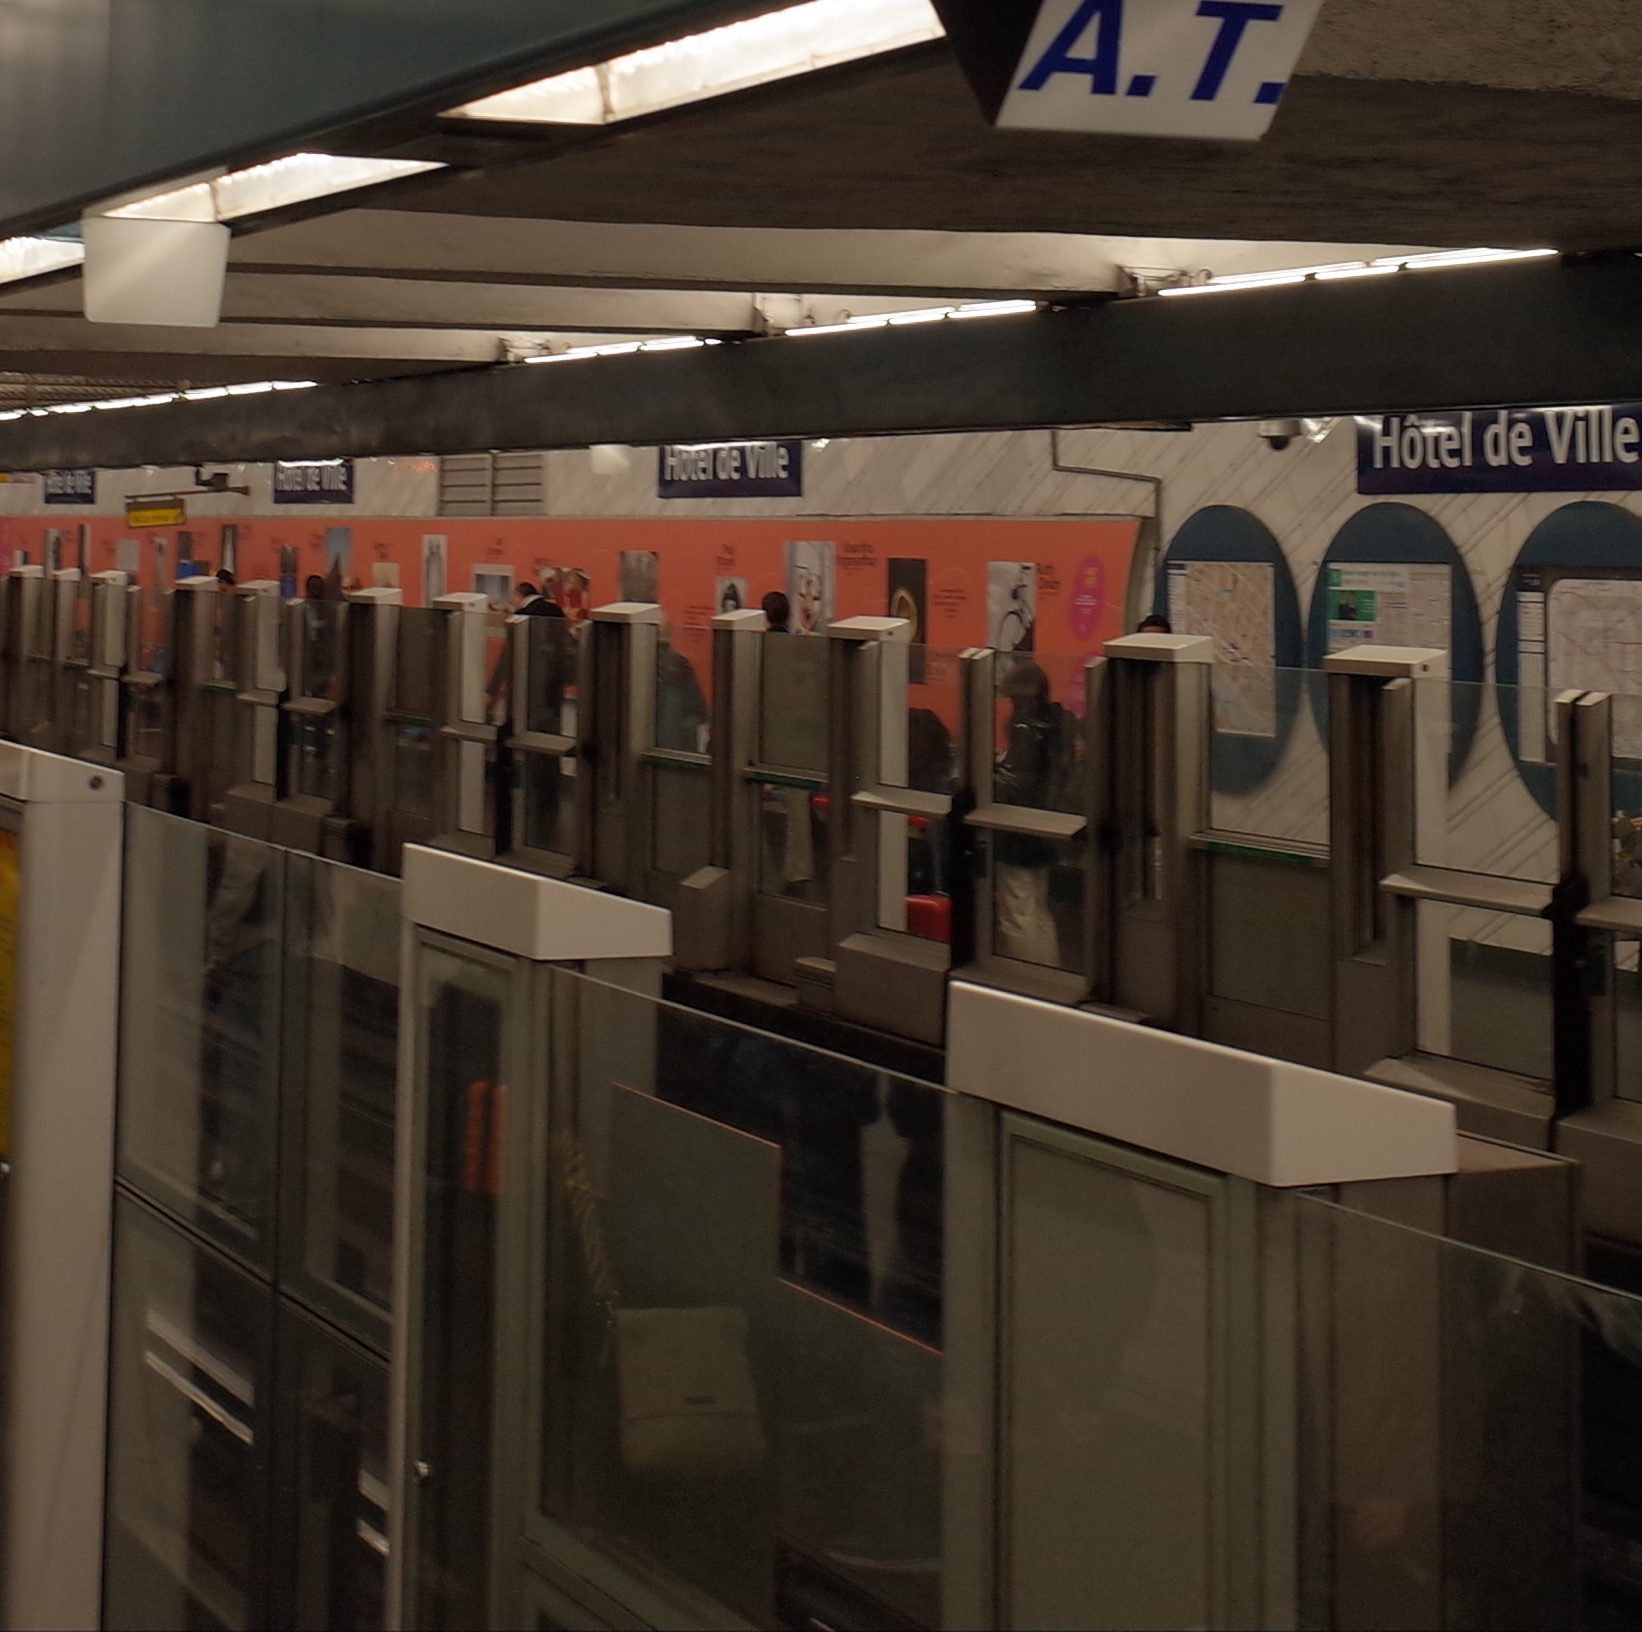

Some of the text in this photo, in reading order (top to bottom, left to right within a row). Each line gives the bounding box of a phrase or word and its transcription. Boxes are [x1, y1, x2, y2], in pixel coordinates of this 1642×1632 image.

[715, 445, 742, 480] de
[744, 442, 790, 479] Ville
[1372, 408, 1641, 469] Hôtel de Ville
